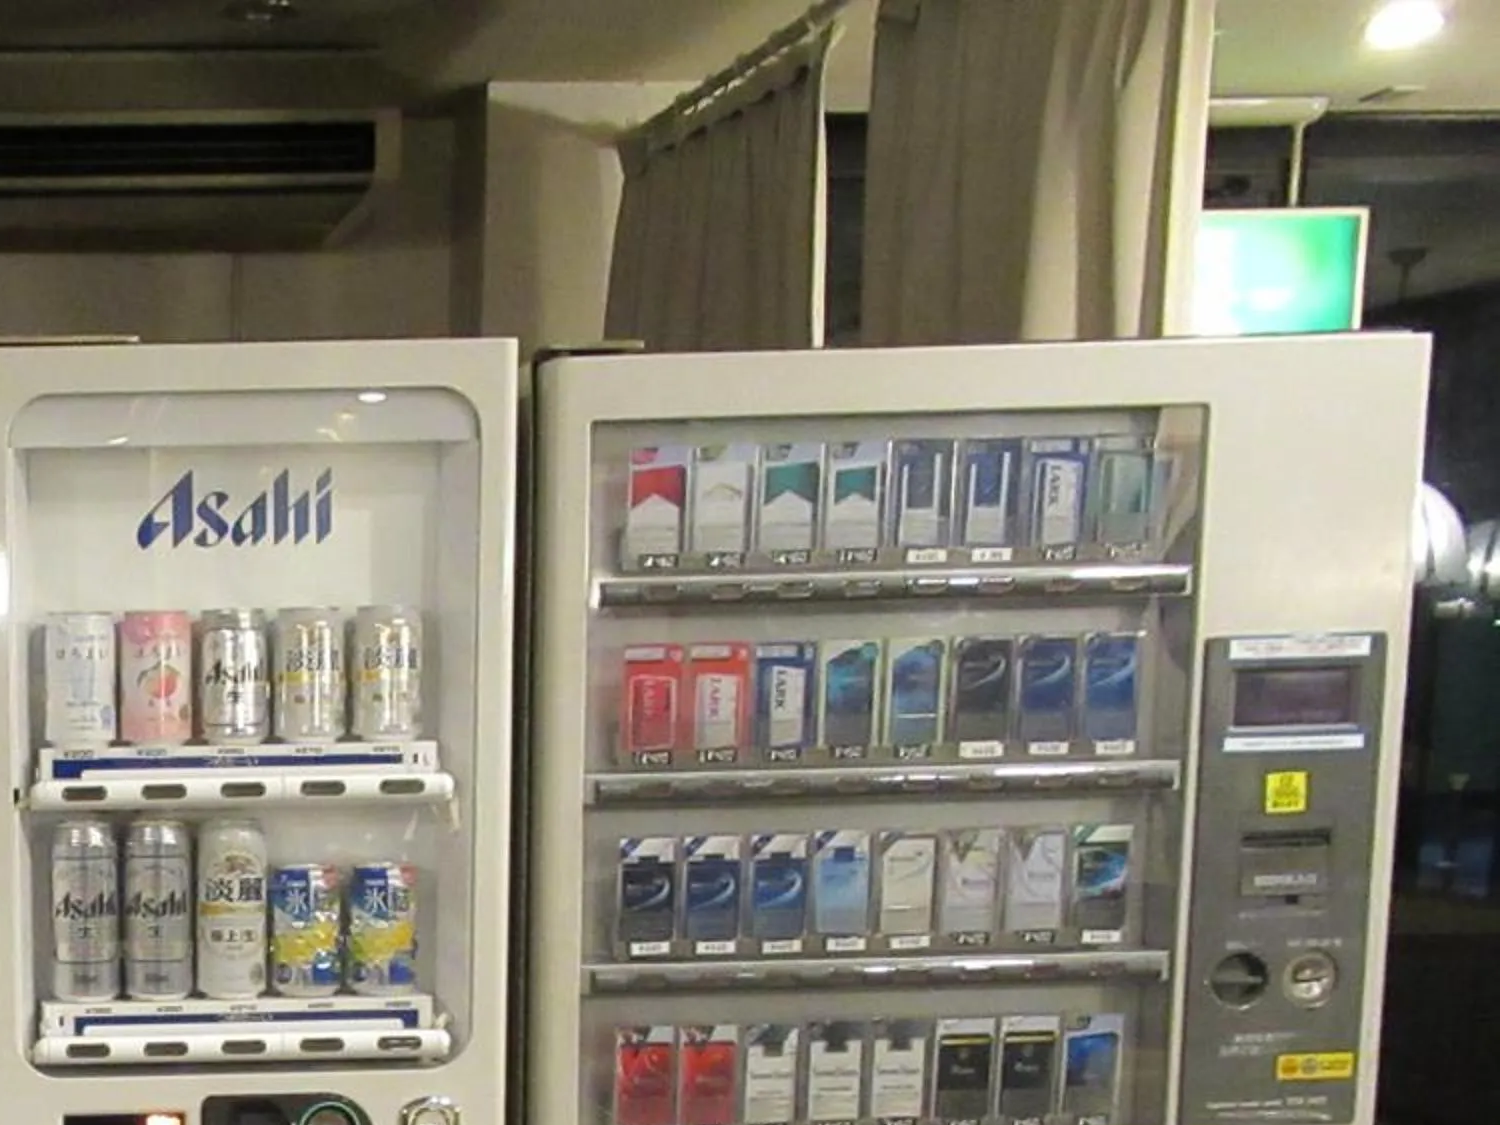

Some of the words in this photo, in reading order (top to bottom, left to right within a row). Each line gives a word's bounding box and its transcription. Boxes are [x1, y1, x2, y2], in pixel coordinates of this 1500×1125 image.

[136, 467, 333, 551] Asahi
[204, 876, 266, 903] 淡麗
[54, 891, 117, 920] Asahi
[124, 890, 188, 919] Asahi
